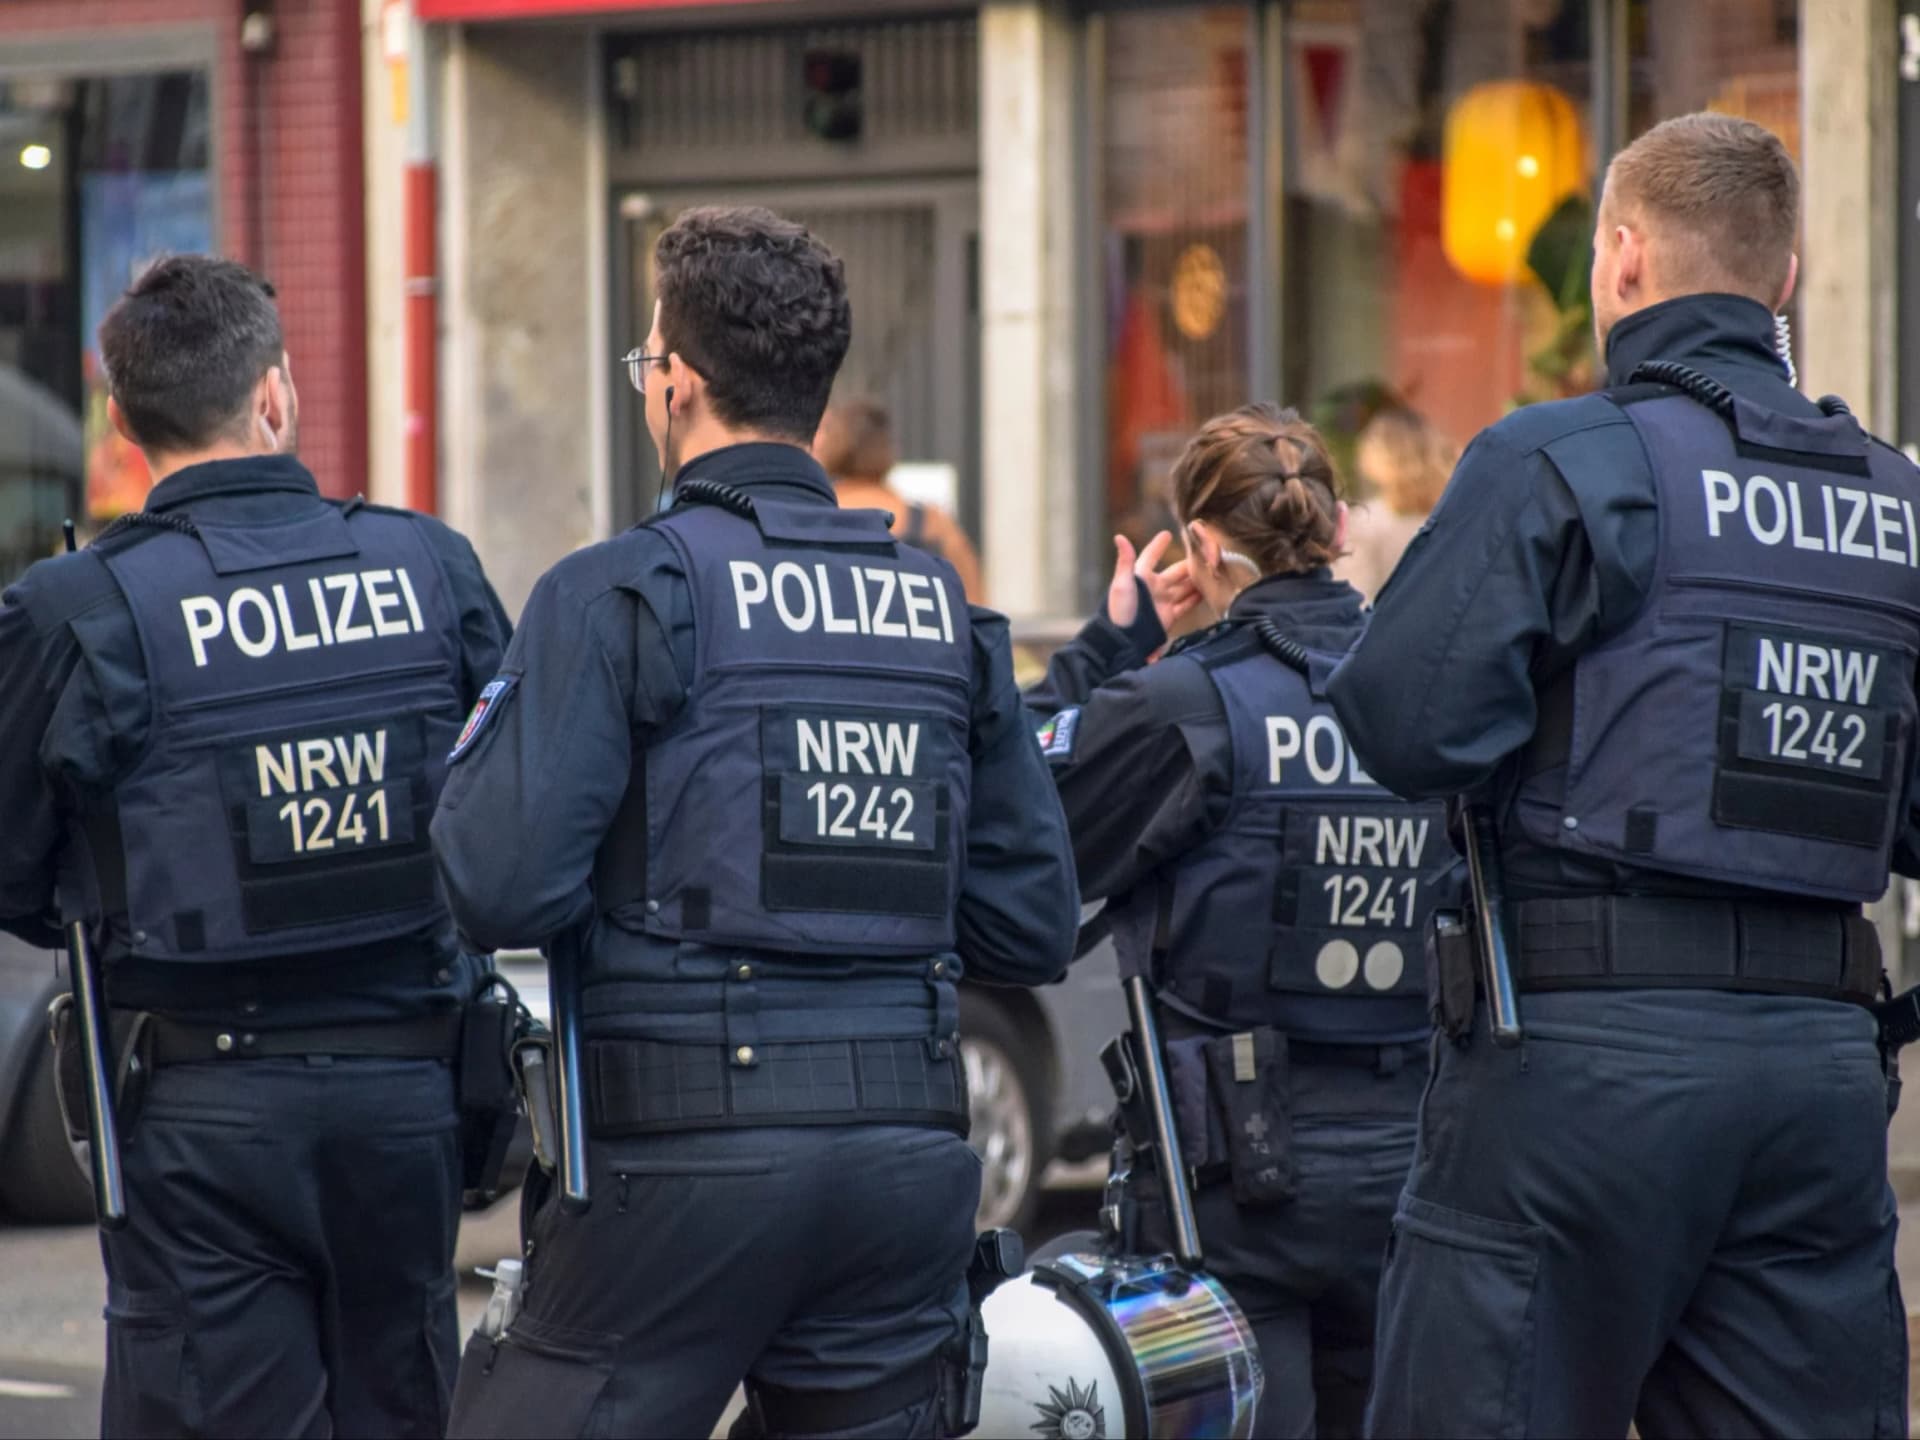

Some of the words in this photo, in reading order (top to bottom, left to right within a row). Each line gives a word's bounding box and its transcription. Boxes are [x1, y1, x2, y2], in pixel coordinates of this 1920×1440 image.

[1701, 469, 1918, 568] POLIZEI
[181, 567, 425, 667] POLIZEI
[729, 560, 954, 644] POLIZEI
[1757, 638, 1879, 705] NRW
[255, 730, 388, 797] NRW
[796, 718, 921, 777] NRW
[1762, 702, 1867, 768] 1242
[278, 789, 390, 852] 1241
[807, 781, 915, 842] 1242
[1316, 816, 1429, 867] NRW
[1323, 874, 1417, 927] 1241
